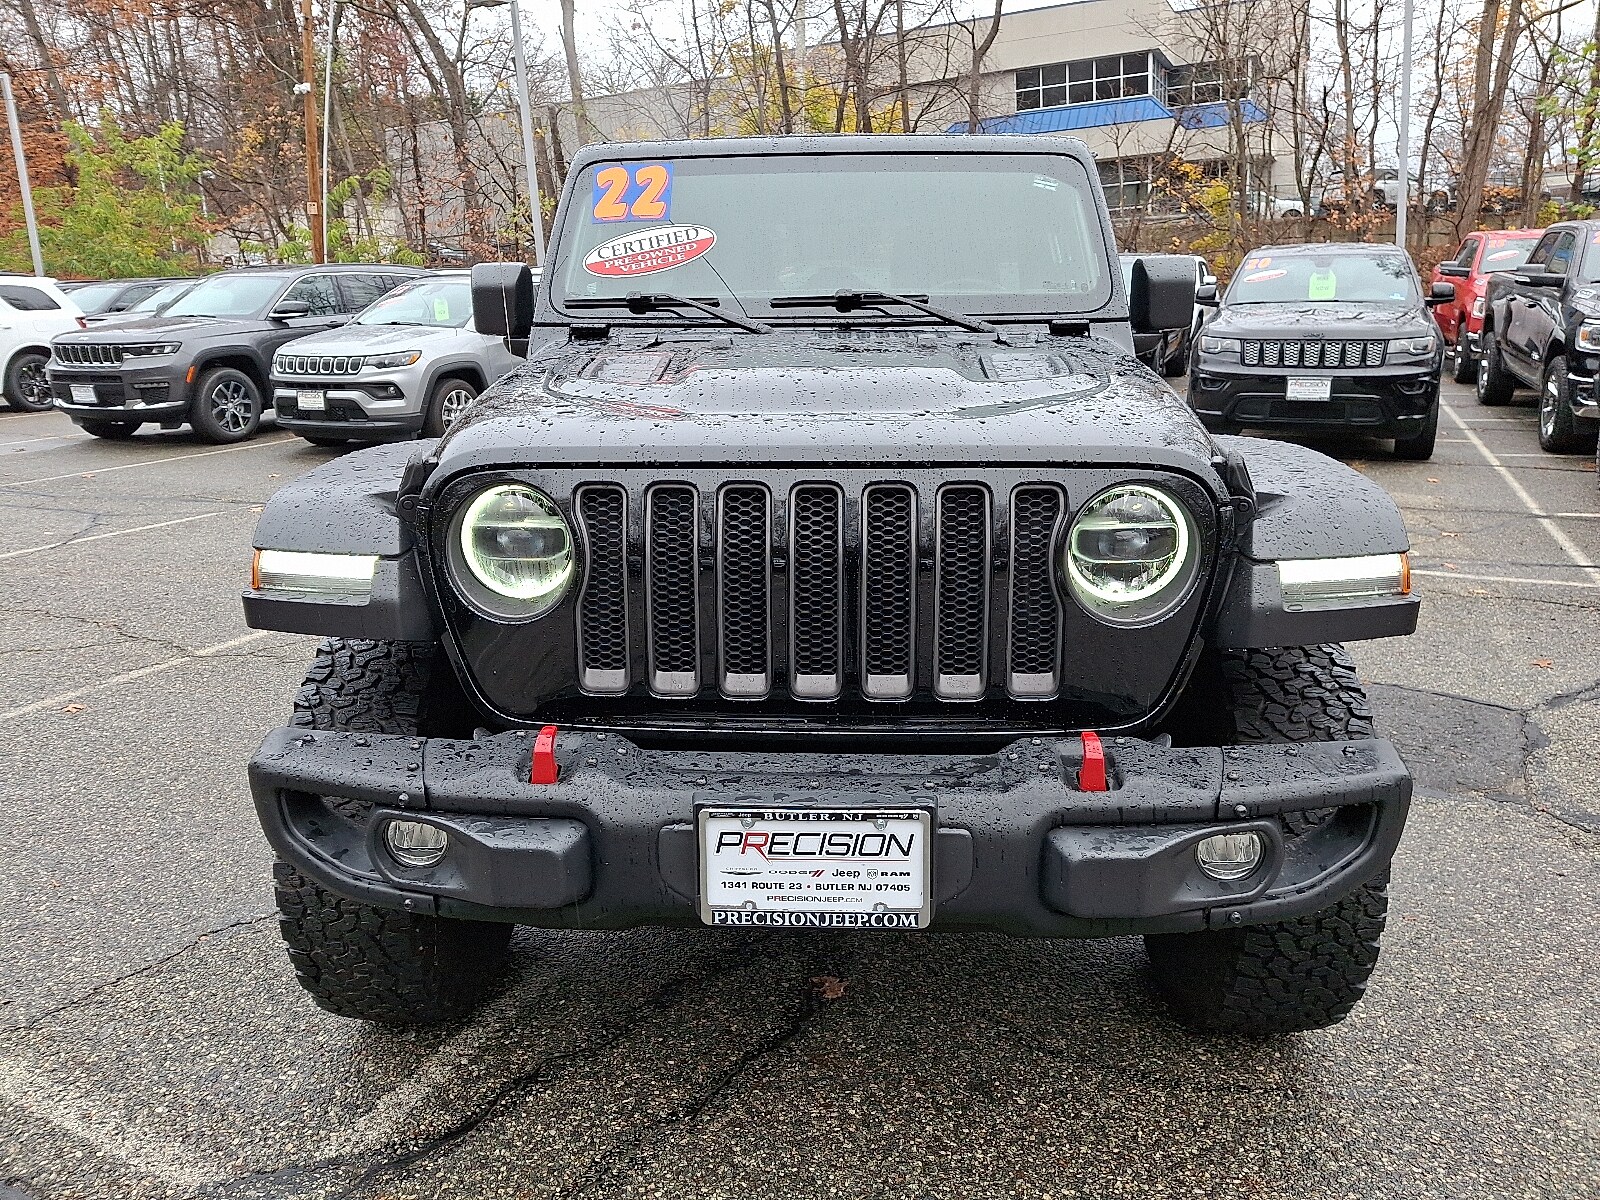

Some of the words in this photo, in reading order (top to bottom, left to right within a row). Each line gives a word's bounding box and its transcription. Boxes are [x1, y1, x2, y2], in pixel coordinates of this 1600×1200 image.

[593, 165, 669, 221] 22
[597, 227, 700, 260] CERTIFIED
[603, 242, 698, 269] PRE-OWNED
[619, 252, 686, 272] VEHICLE
[763, 812, 836, 821] BUTLER,
[842, 813, 864, 821] NJ
[715, 831, 915, 857] PRECISION
[832, 868, 861, 880] Jeep
[721, 881, 747, 889] 1341
[751, 882, 785, 890] ROUTE
[788, 882, 803, 890] 23
[815, 883, 855, 891] BUTLER
[858, 883, 872, 891] NJ
[875, 883, 911, 892] 07405
[712, 911, 918, 928] PRECISIONJEEP.COM
